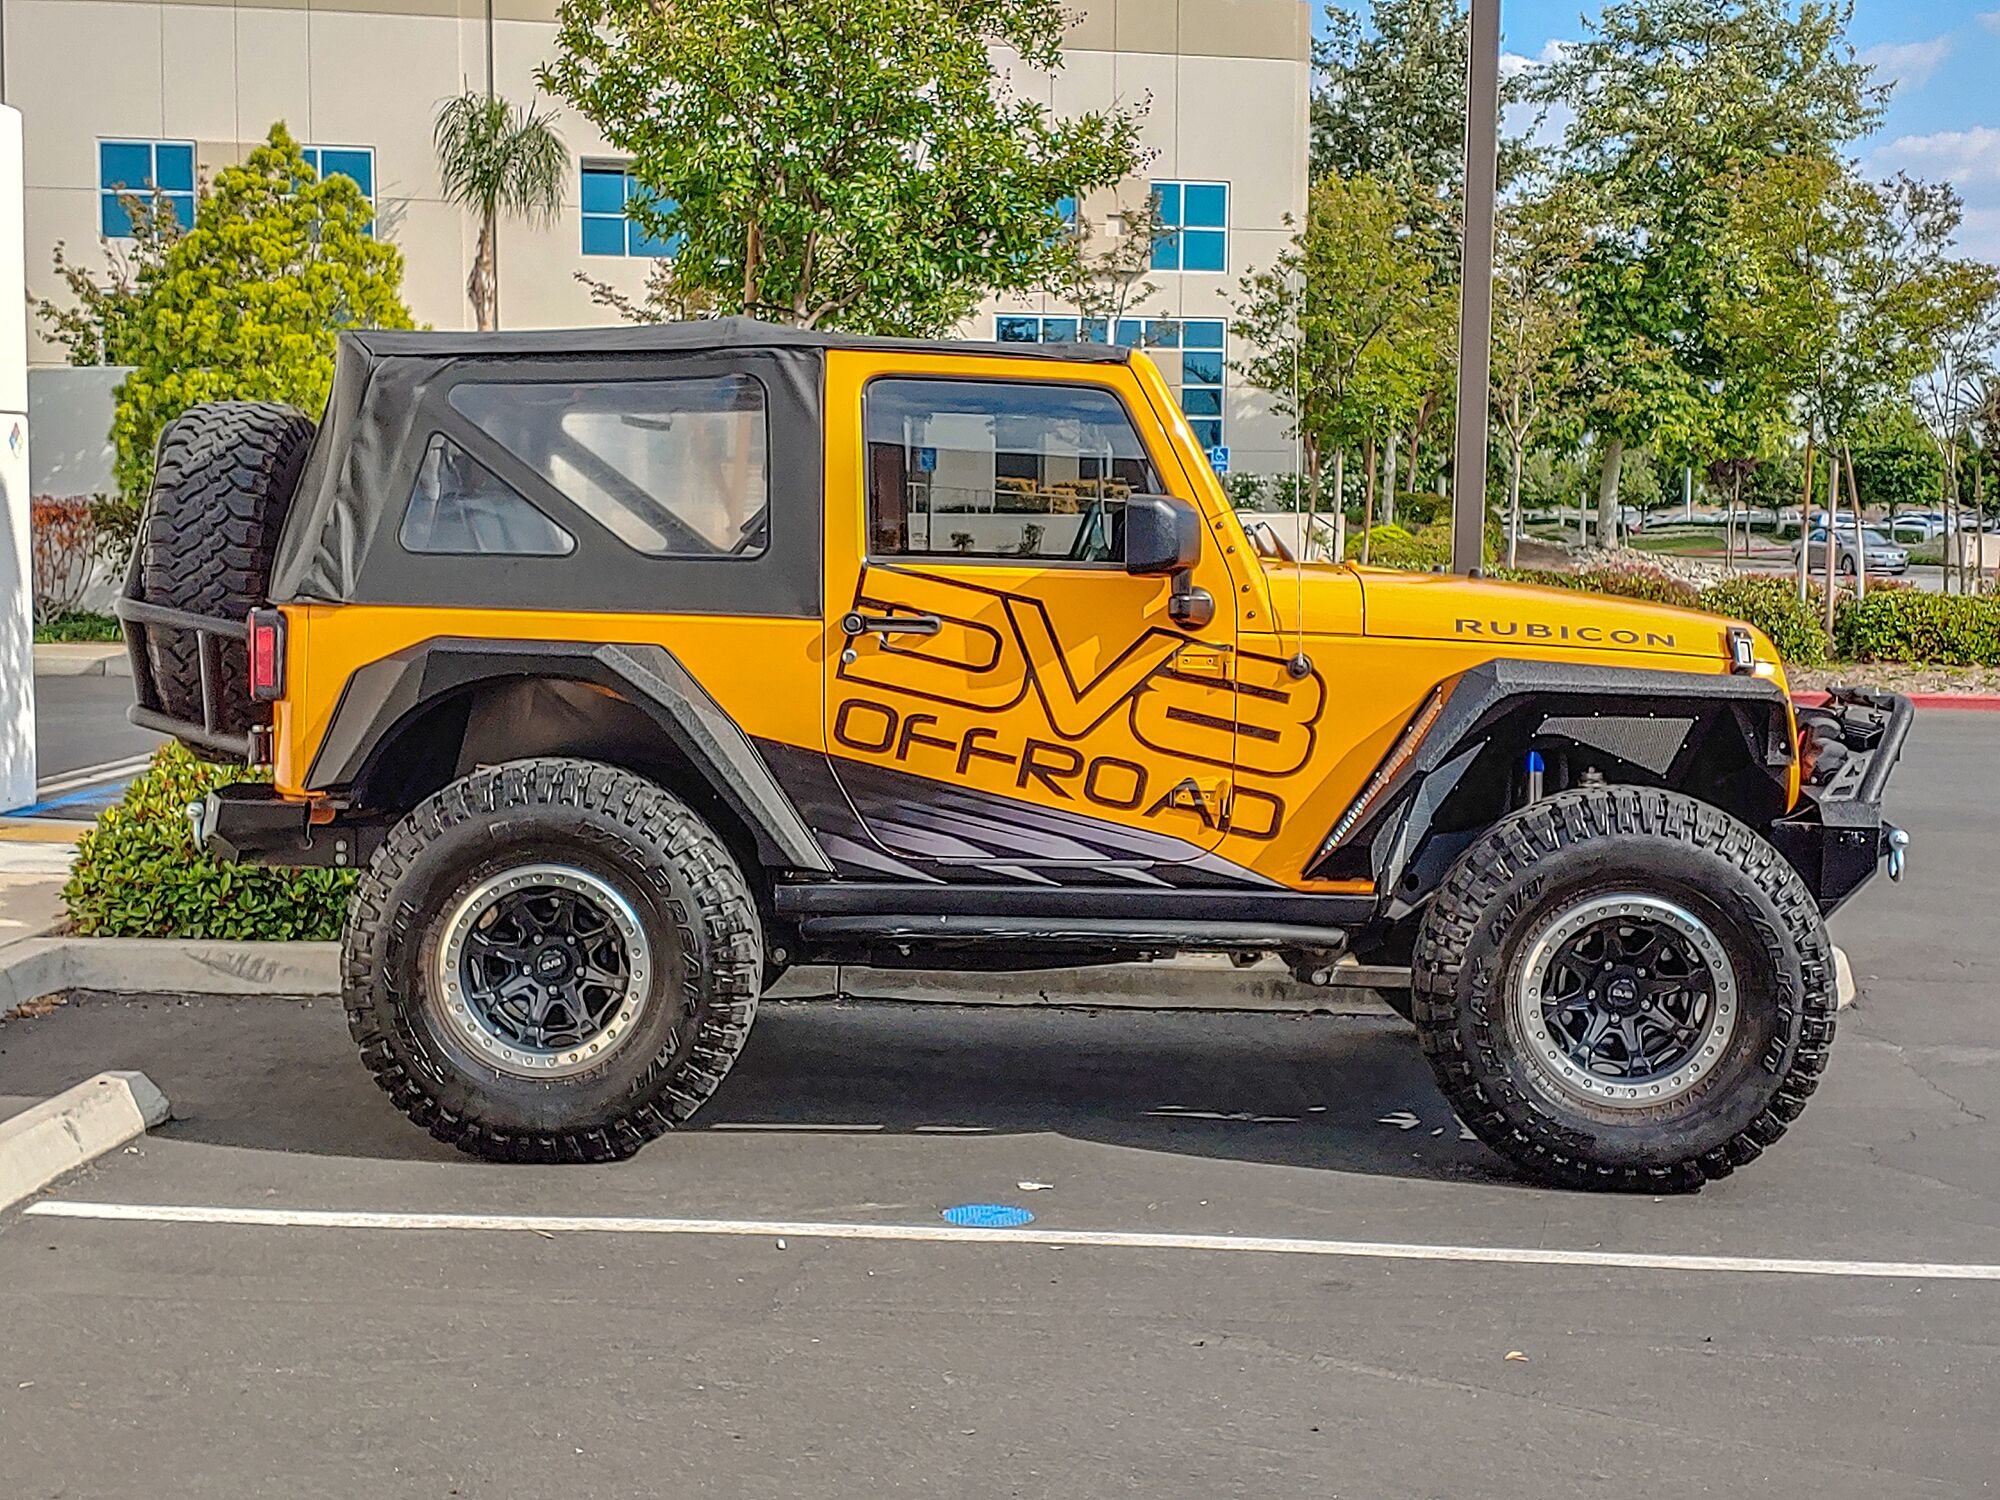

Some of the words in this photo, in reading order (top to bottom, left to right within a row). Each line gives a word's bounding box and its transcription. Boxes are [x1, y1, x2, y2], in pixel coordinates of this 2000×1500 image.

[837, 561, 1326, 777] DV8
[1455, 618, 1676, 648] RUBICON
[833, 699, 1286, 840] OFFROAD
